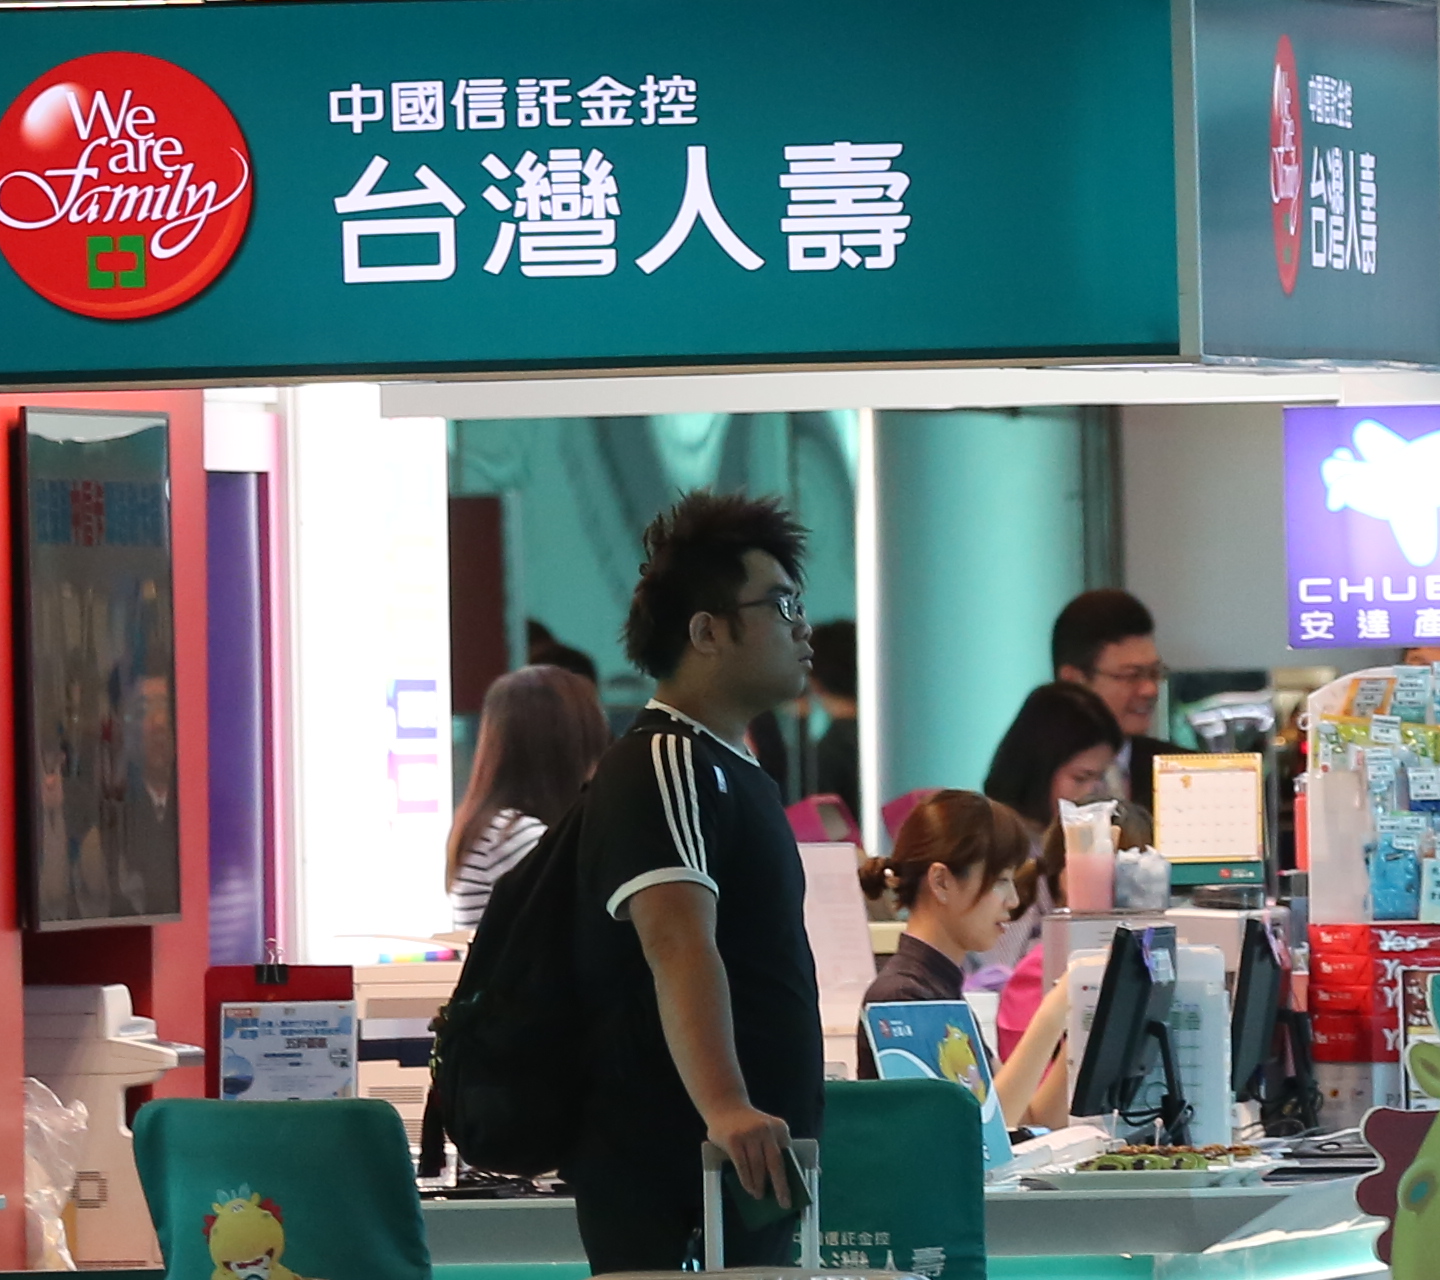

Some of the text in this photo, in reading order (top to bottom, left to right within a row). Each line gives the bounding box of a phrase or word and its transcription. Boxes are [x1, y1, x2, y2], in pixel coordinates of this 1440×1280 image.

[65, 89, 156, 140] We
[329, 74, 698, 134] 中國信託金控
[108, 136, 184, 173] are
[334, 141, 912, 284] 台灣人壽
[1311, 147, 1377, 275] 台灣人壽
